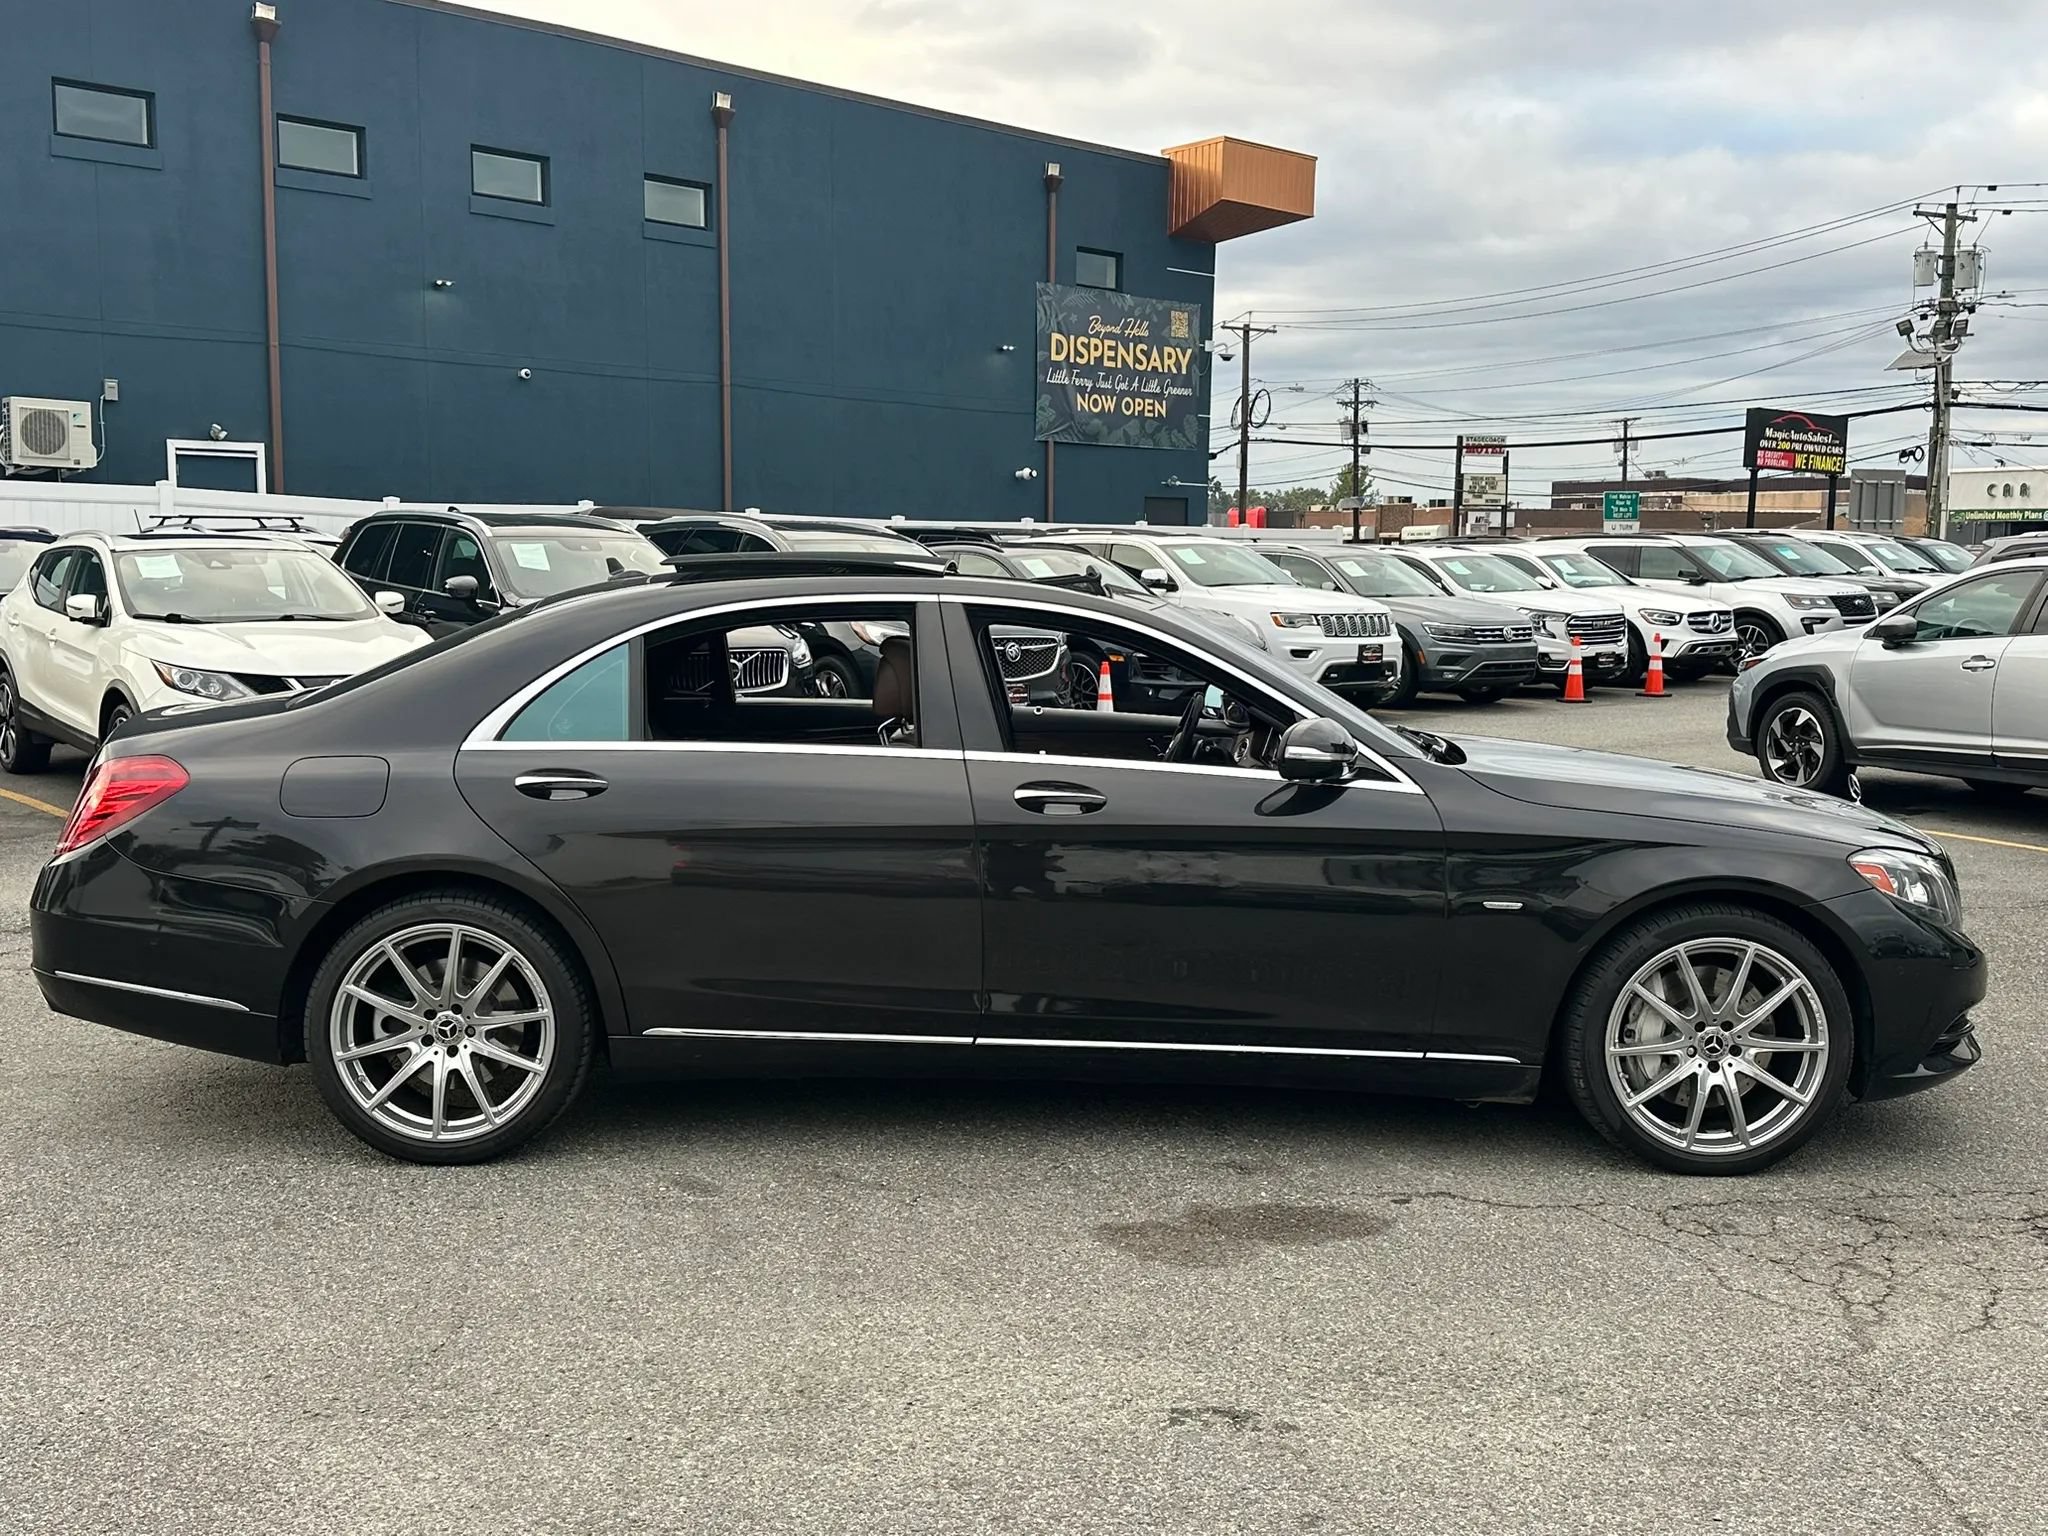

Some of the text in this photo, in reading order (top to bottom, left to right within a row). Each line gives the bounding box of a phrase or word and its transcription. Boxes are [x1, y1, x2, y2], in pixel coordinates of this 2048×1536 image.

[1088, 315, 1124, 338] Beyond
[1050, 332, 1193, 375] DISPENSARY
[1046, 367, 1193, 397] Little Ferry Just Got A Little Greener
[1076, 392, 1167, 418] NOW OPEN
[1759, 439, 1777, 449] OVER
[1777, 441, 1791, 450] 200
[1826, 446, 1844, 455] CARS
[1795, 453, 1845, 472] WE FINANCE!
[1965, 510, 2043, 521] Unlimited Monthly Plans
